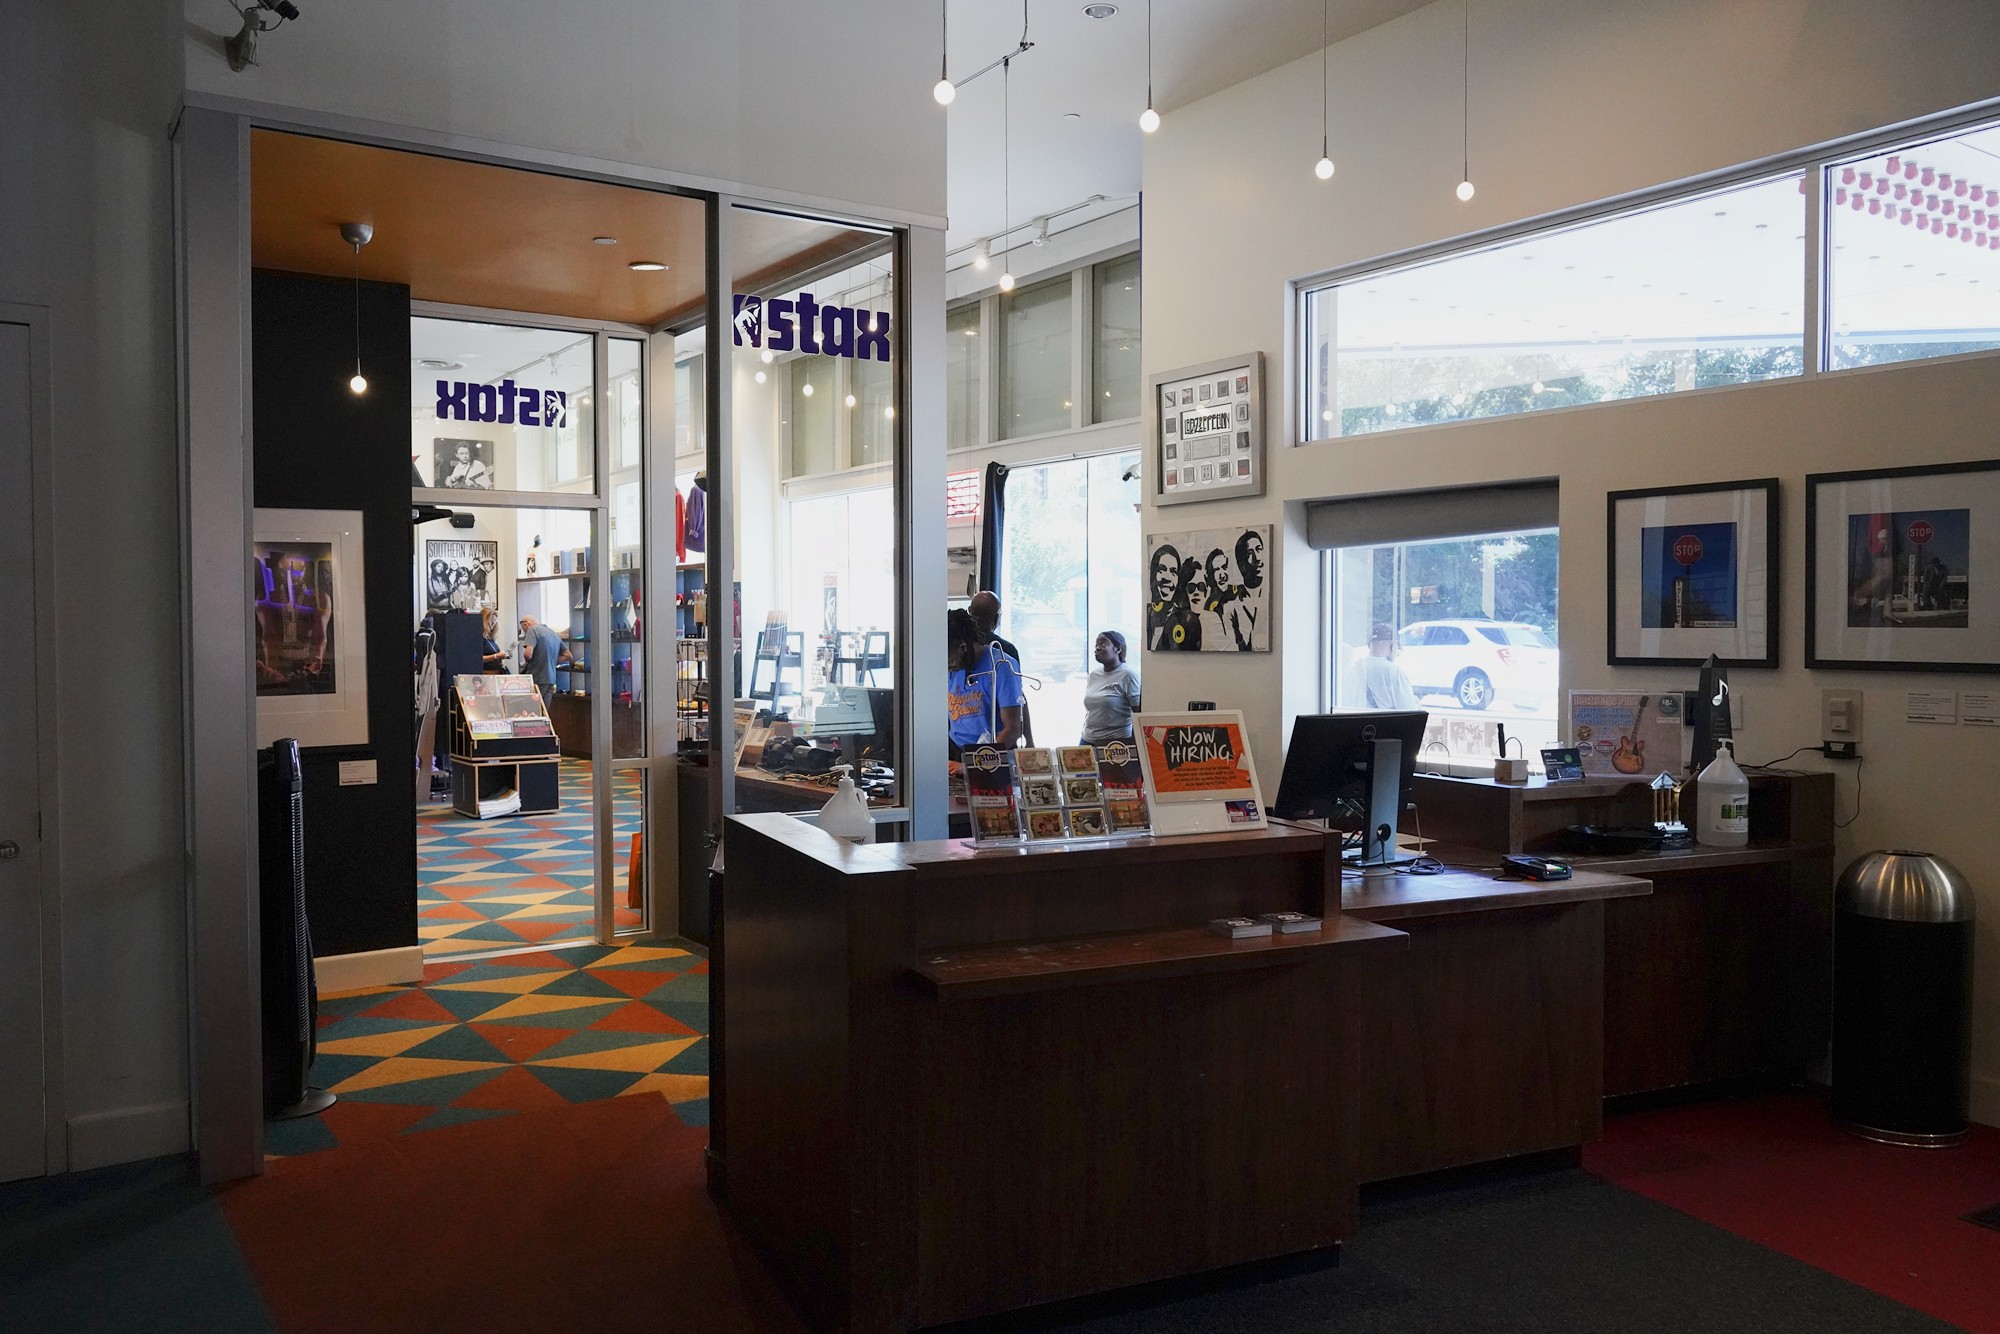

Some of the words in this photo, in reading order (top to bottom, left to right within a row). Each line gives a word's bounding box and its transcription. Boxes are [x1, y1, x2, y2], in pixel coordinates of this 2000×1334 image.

[768, 292, 890, 362] stax
[1910, 527, 1932, 537] STOP
[428, 541, 466, 558] SOUTHERN
[469, 543, 495, 559] AVENUE
[1676, 544, 1701, 556] STOP
[1170, 742, 1230, 764] HIRING
